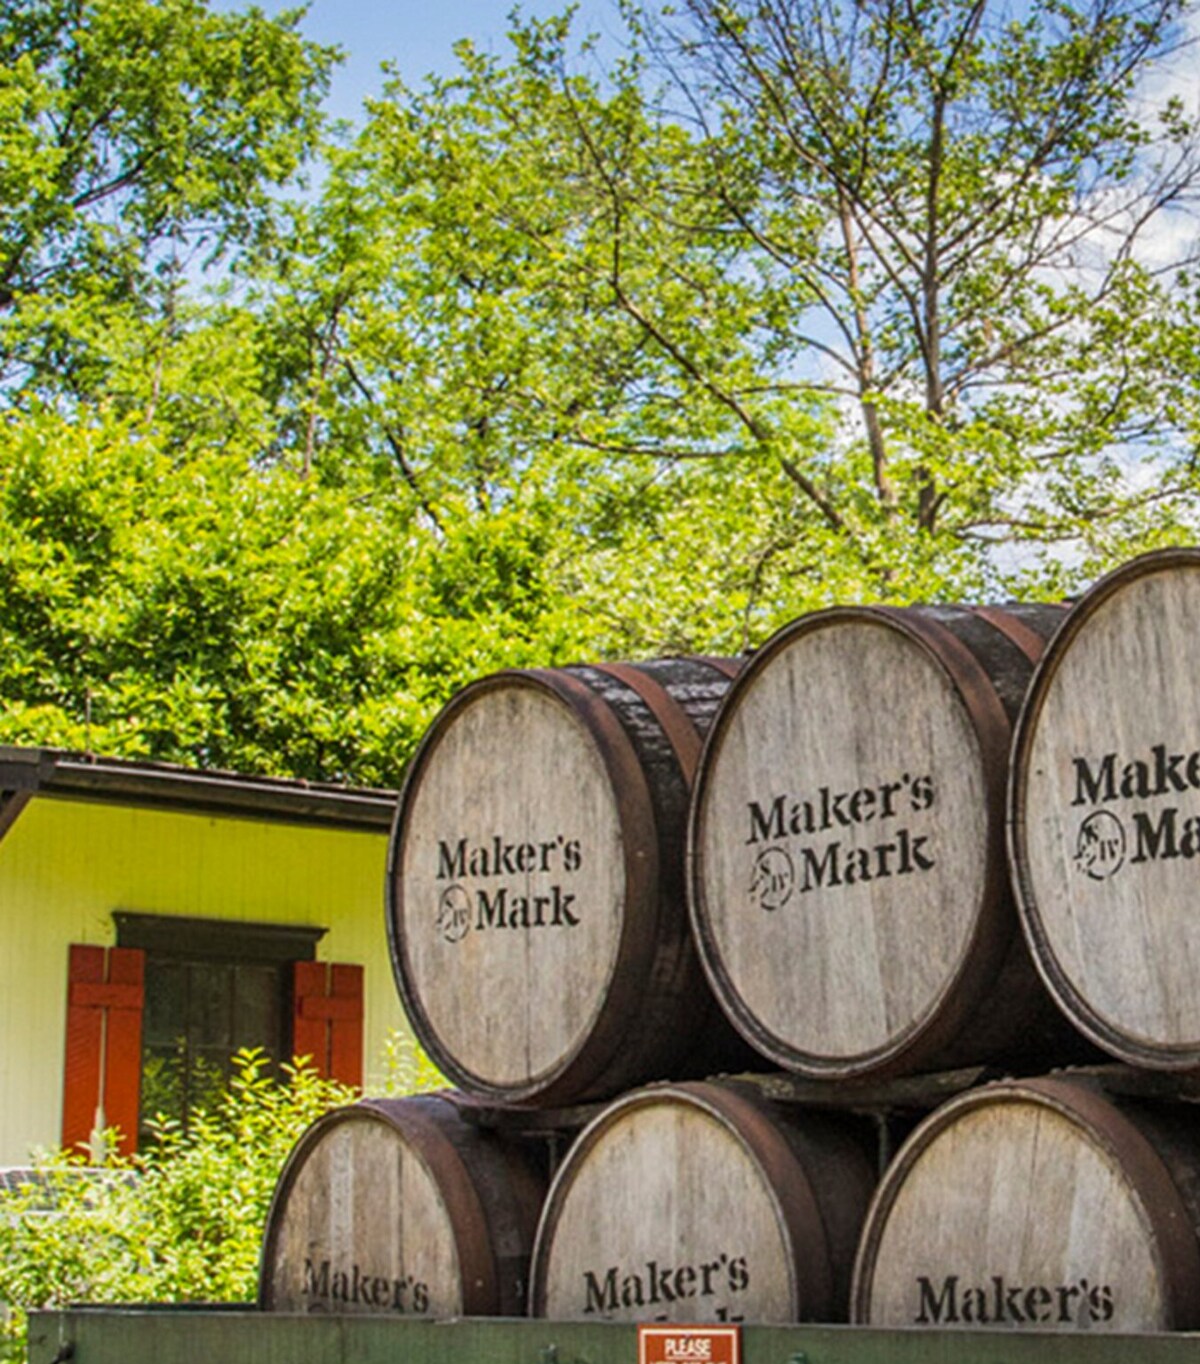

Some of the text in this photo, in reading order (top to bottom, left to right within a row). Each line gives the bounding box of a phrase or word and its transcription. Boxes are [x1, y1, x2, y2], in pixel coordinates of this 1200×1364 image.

[745, 773, 935, 845] Maker's
[436, 835, 582, 880] Maker's
[800, 829, 935, 893] Mark
[475, 886, 580, 930] Mark
[302, 1258, 429, 1314] Maker's
[583, 1253, 749, 1313] Maker's
[914, 1275, 1114, 1324] Maker's
[665, 1338, 711, 1356] PLEASE
